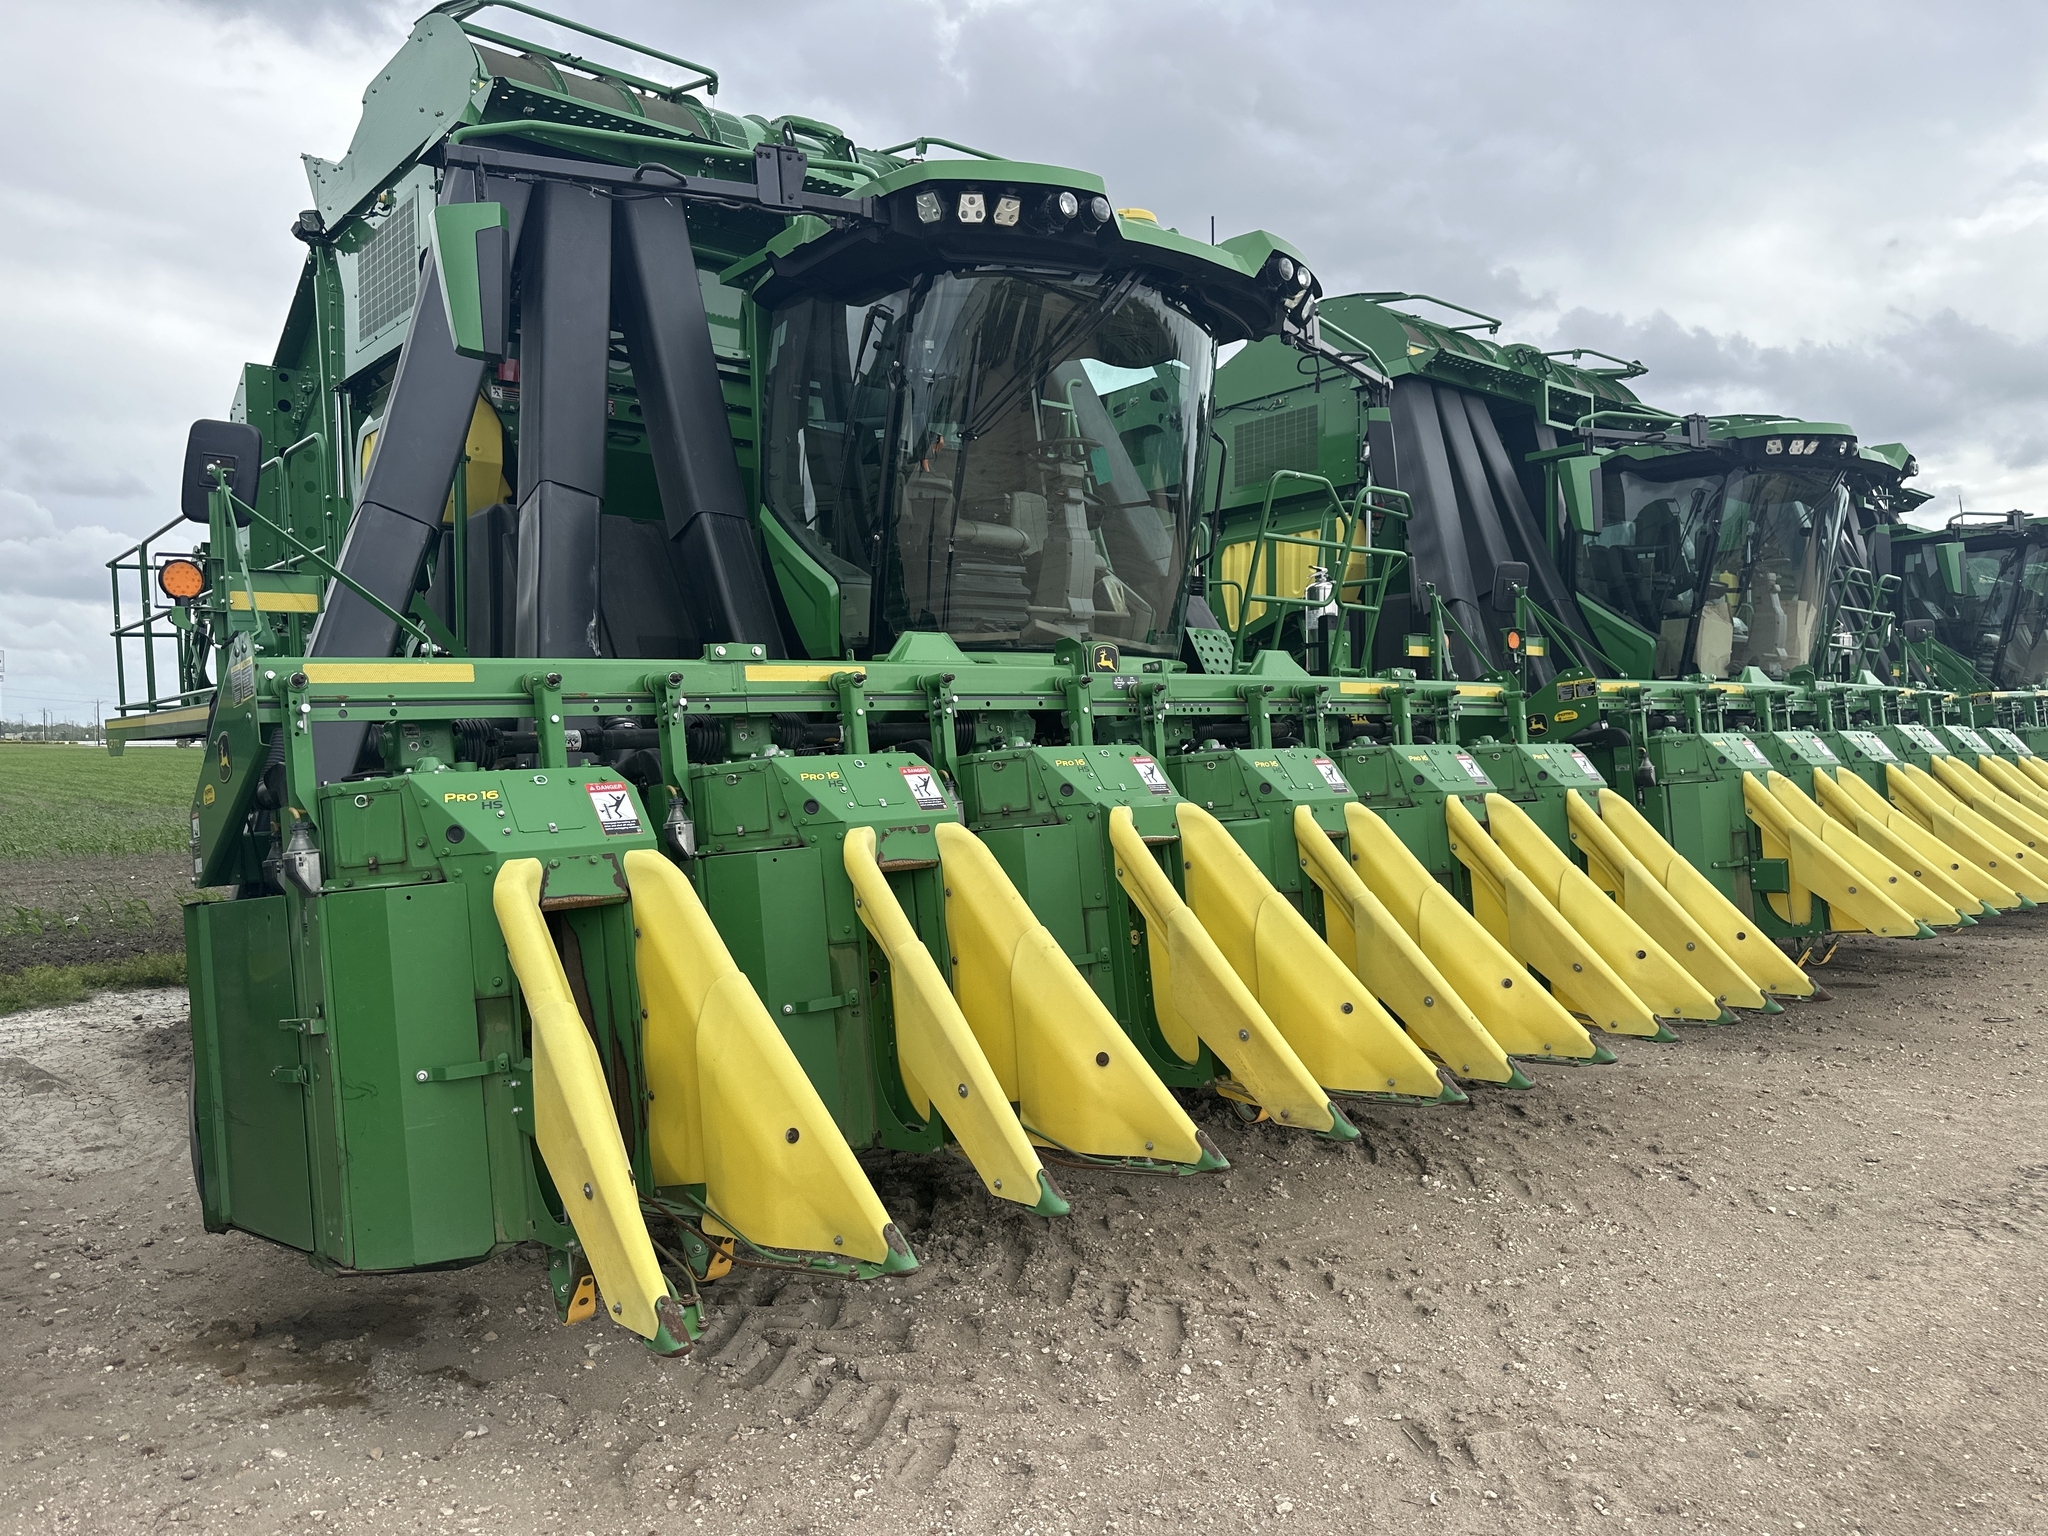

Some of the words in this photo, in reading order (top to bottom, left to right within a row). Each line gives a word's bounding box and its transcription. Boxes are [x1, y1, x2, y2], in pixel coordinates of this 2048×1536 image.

[1074, 758, 1086, 766] 16
[800, 773, 826, 782] PRO
[825, 771, 840, 780] 16
[595, 783, 624, 791] DANGER
[828, 780, 845, 788] HS
[444, 793, 479, 803] PRO
[480, 790, 500, 800] 16
[481, 801, 503, 810] HS
